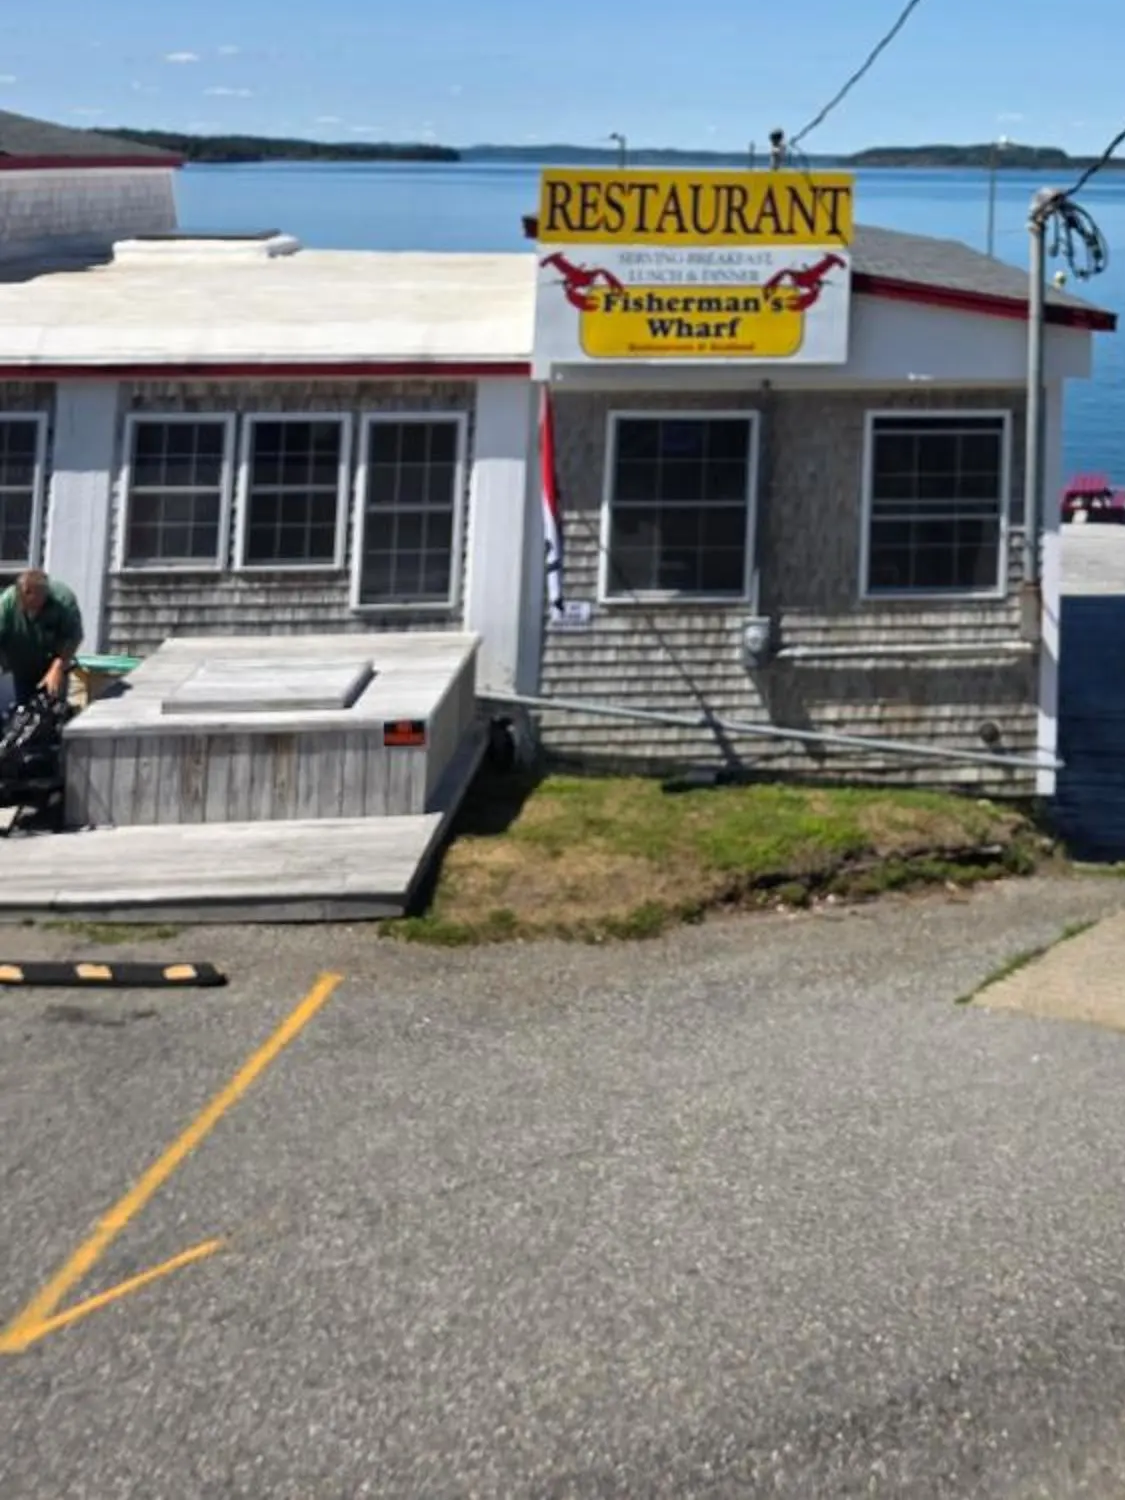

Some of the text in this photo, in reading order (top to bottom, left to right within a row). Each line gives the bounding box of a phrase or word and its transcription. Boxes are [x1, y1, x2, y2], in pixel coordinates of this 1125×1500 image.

[545, 180, 851, 236] RESTAURANT
[603, 292, 784, 312] Fisherman's
[647, 317, 741, 338] Wharf
